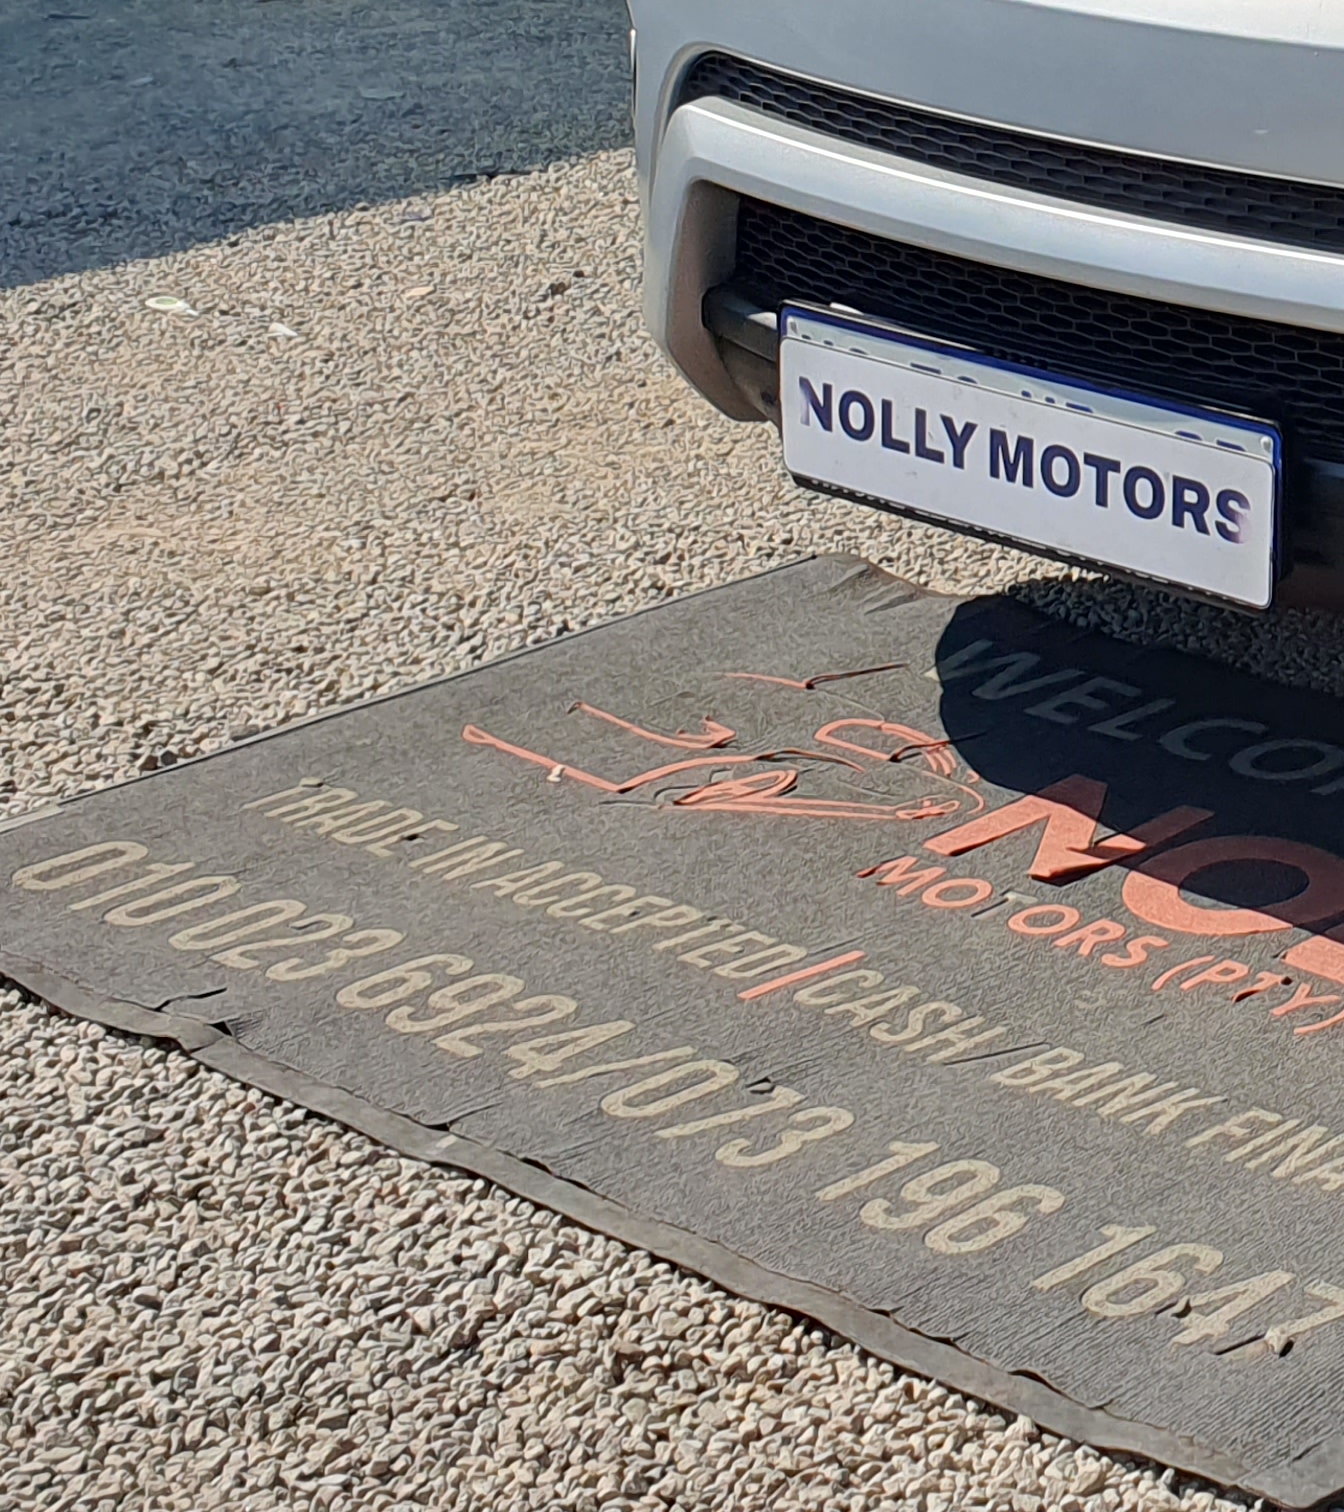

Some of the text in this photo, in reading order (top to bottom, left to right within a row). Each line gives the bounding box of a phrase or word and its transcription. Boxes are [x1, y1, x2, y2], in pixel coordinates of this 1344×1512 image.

[798, 376, 1252, 543] NOLLY MOTORS
[242, 777, 459, 858] TRADE
[408, 835, 524, 880] IN
[857, 855, 1169, 968] MOTORS
[815, 1139, 1066, 1255] 196
